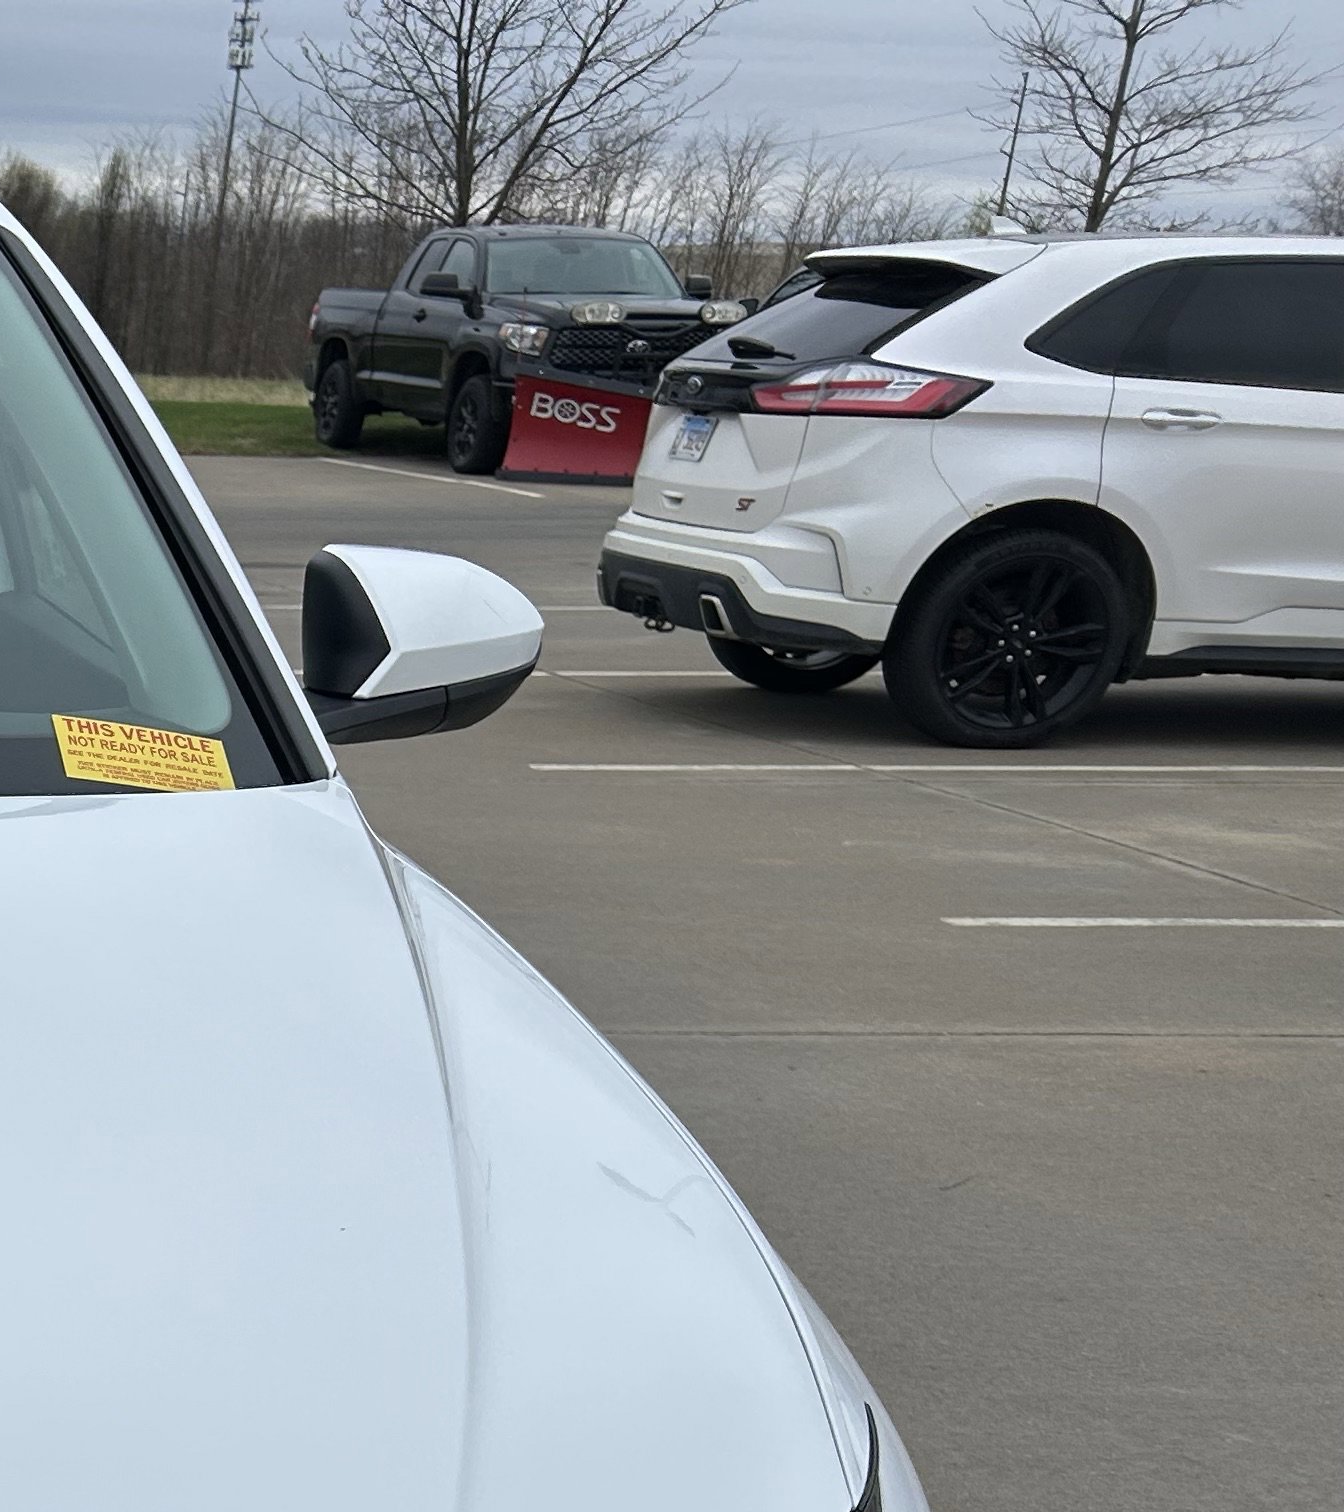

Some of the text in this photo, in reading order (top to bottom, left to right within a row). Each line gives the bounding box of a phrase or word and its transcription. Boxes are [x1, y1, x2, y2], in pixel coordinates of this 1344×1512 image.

[530, 392, 621, 433] BOSS
[62, 718, 214, 754] THIS VEHICLE
[67, 735, 217, 767] NOT READY FOR SALE
